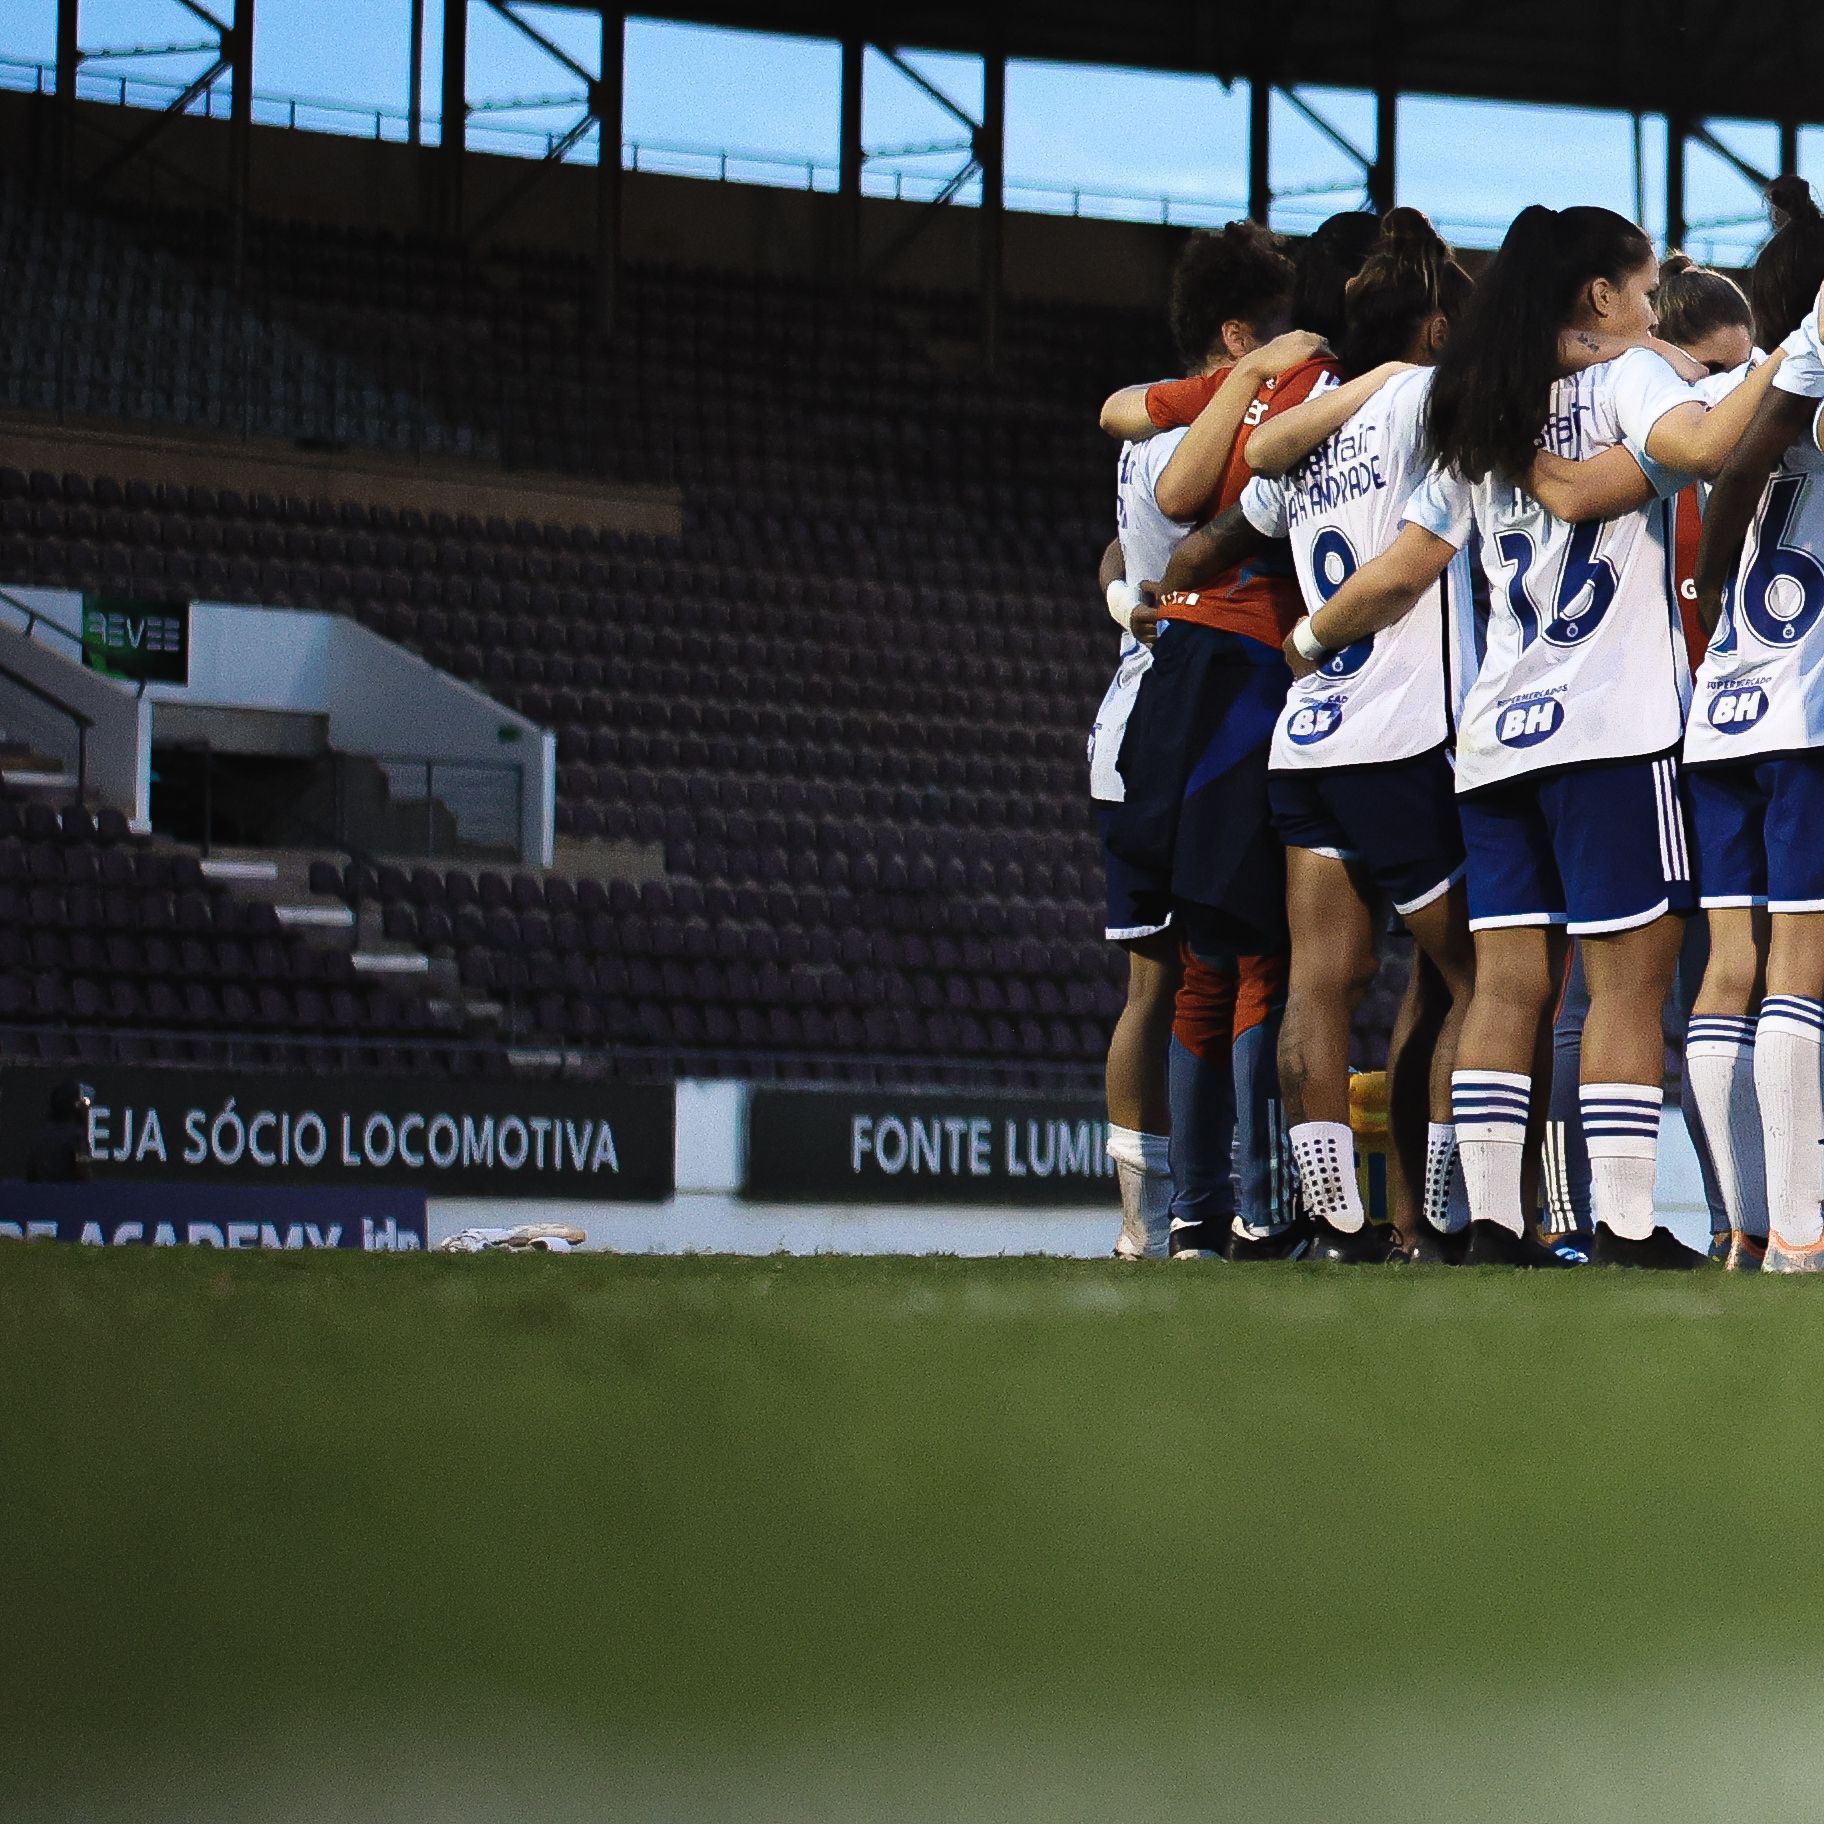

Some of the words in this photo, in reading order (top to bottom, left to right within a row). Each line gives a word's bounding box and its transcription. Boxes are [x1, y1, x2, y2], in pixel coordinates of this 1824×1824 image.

[1500, 700, 1556, 741] BH
[1712, 689, 1762, 725] BH
[87, 1105, 167, 1163] EJA
[183, 1096, 327, 1167] SÓCIO
[341, 1112, 620, 1174] LOCOMOTIVA
[851, 1114, 992, 1176] FONTE
